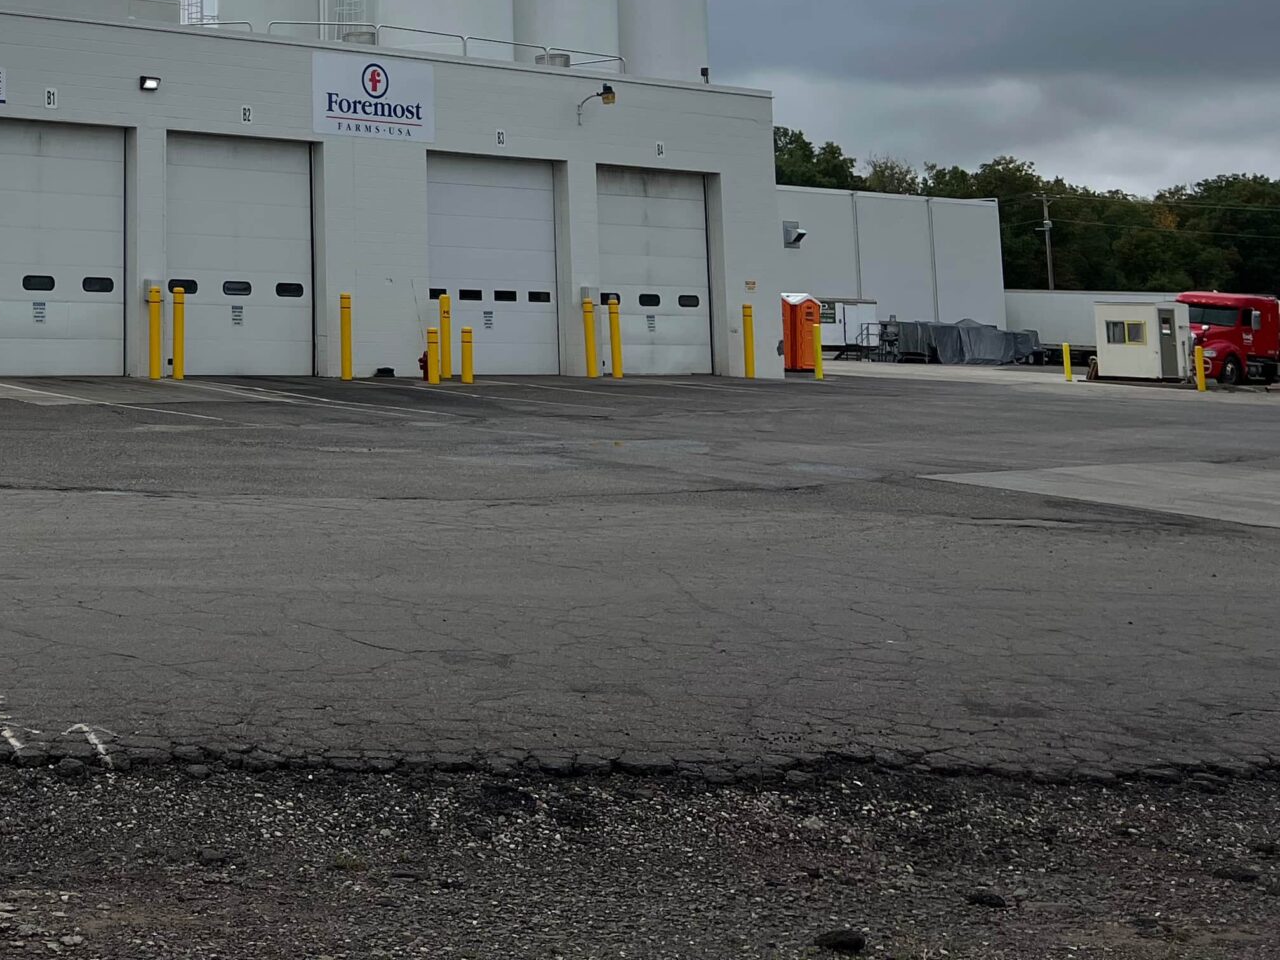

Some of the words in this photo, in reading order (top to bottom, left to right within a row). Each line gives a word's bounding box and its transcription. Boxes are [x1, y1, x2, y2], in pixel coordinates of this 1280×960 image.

[46, 90, 55, 106] B1
[326, 92, 422, 120] Foremost
[242, 107, 251, 122] B2
[497, 131, 505, 145] B3
[656, 143, 664, 156] B4
